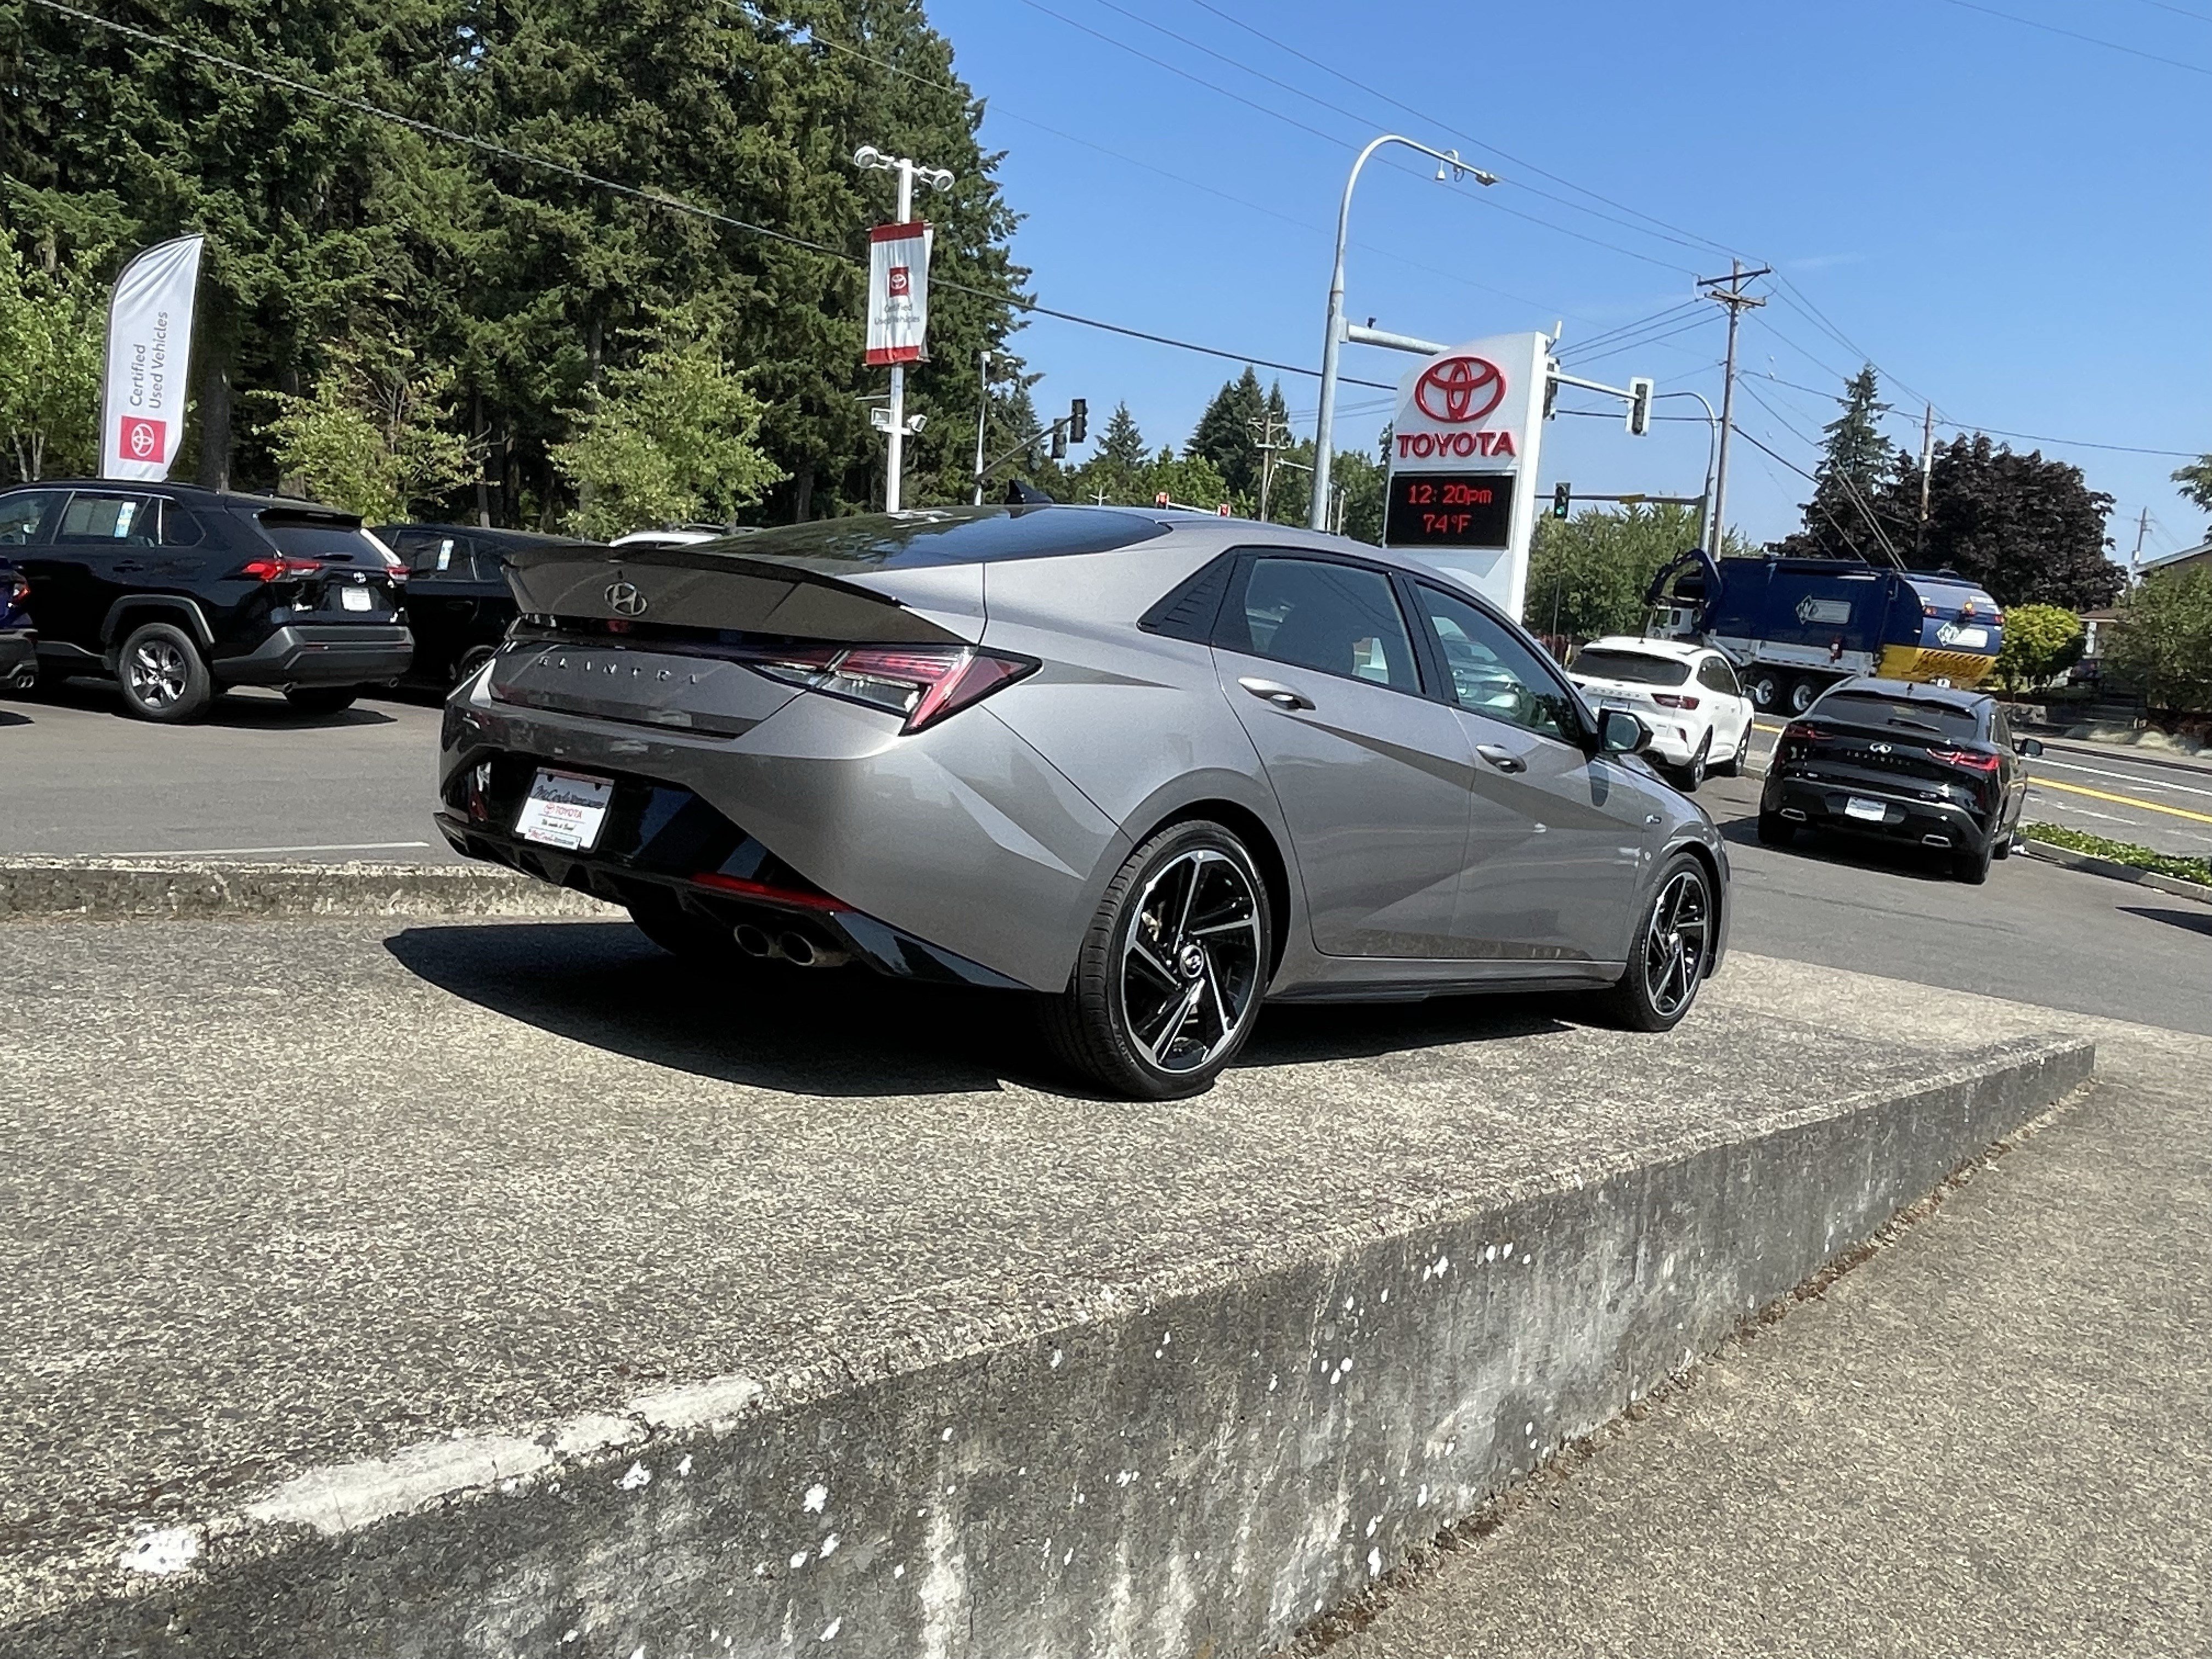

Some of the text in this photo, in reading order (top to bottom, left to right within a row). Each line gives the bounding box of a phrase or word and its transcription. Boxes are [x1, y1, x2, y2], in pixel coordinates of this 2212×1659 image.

[884, 303, 913, 313] Certed
[148, 311, 168, 409] Used Vehicles
[129, 343, 146, 407] Certified
[1396, 431, 1516, 459] TOYOTA
[1423, 514, 1472, 534] 74°F
[556, 806, 582, 819] TOYOTA
